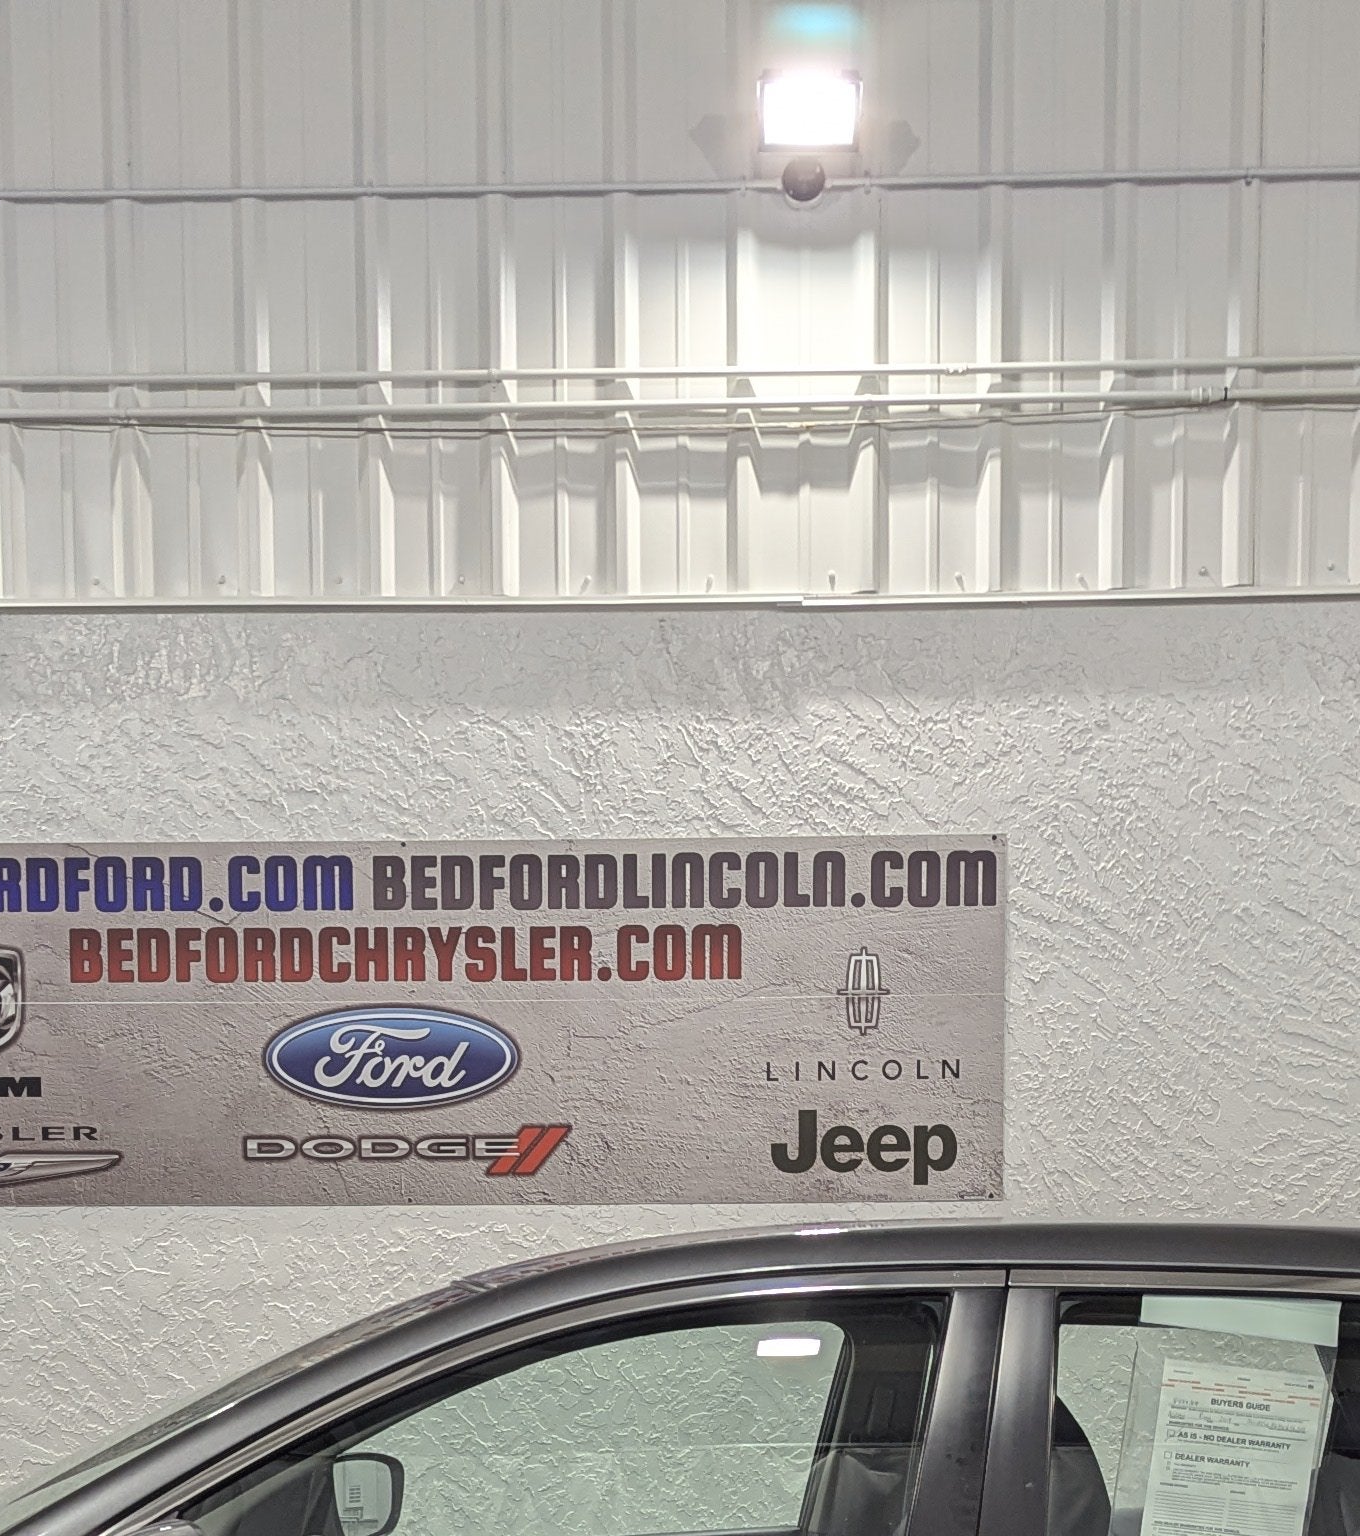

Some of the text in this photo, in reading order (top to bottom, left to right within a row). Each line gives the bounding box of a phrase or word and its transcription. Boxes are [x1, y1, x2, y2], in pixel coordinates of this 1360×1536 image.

[373, 850, 997, 910] BEDFORDLINCOLN.COM
[69, 923, 742, 983] BEDFORDCHRYSLER.COM
[314, 1024, 470, 1088] Ford
[766, 1059, 960, 1082] LINCOLN
[244, 1137, 521, 1160] DODGE
[770, 1109, 958, 1185] Jeep
[1210, 1398, 1244, 1409] BUYERS
[1245, 1401, 1271, 1412] GUIDE
[1177, 1430, 1189, 1440] AS
[1190, 1432, 1198, 1440] IS
[1203, 1433, 1215, 1442] NO
[1216, 1435, 1247, 1446] DEALER
[1248, 1439, 1291, 1450] WARRANTY
[1174, 1452, 1206, 1463] DEALER
[1207, 1456, 1251, 1468] WARRANTY
